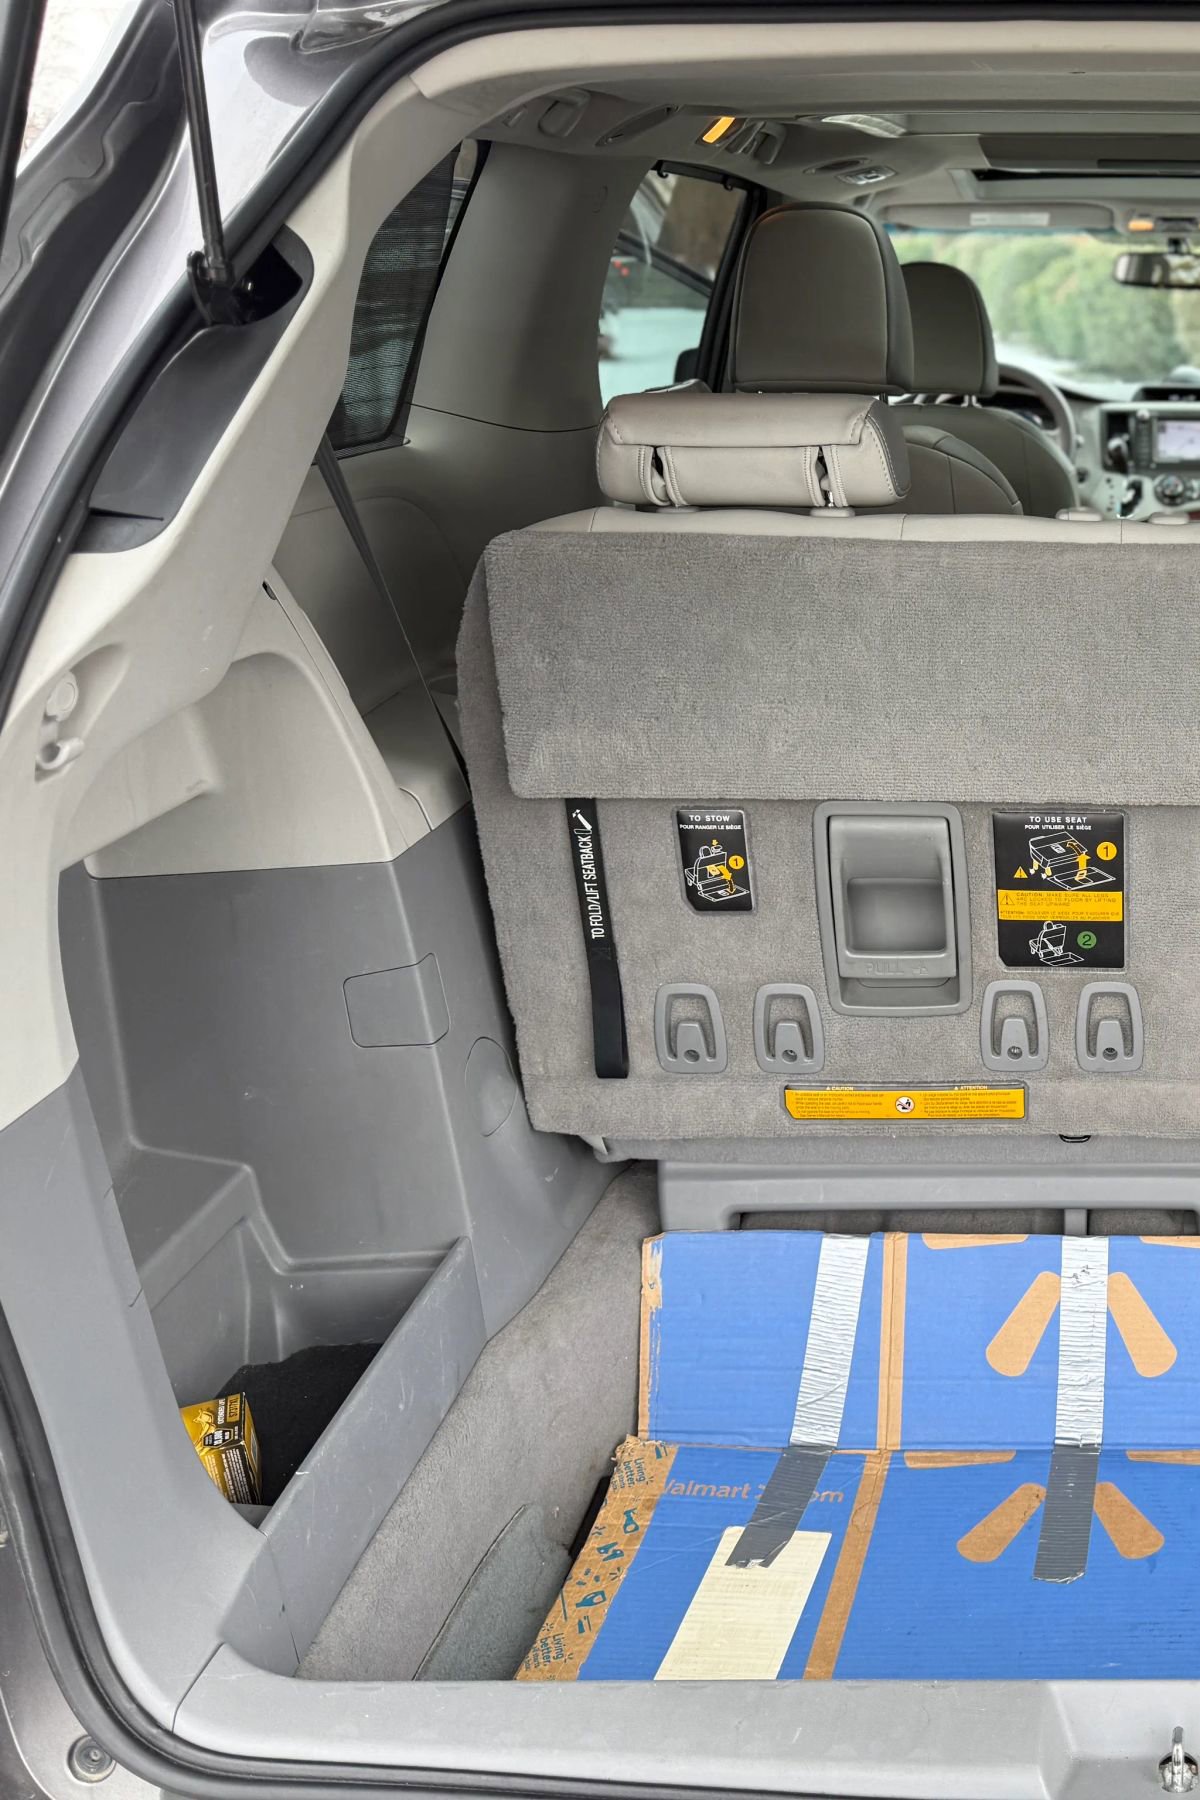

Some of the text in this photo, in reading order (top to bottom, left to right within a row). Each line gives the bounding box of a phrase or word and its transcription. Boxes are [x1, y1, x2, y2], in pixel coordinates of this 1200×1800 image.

[1102, 846, 1109, 857] 1
[578, 836, 605, 940] TO FOLD/LIFT SEATBACK
[1082, 934, 1092, 946] 2
[864, 962, 904, 976] PULL
[624, 1460, 635, 1488] better.
[634, 1457, 647, 1483] Living
[661, 1480, 752, 1500] almart
[540, 1636, 552, 1667] better.
[552, 1632, 566, 1660] Living
